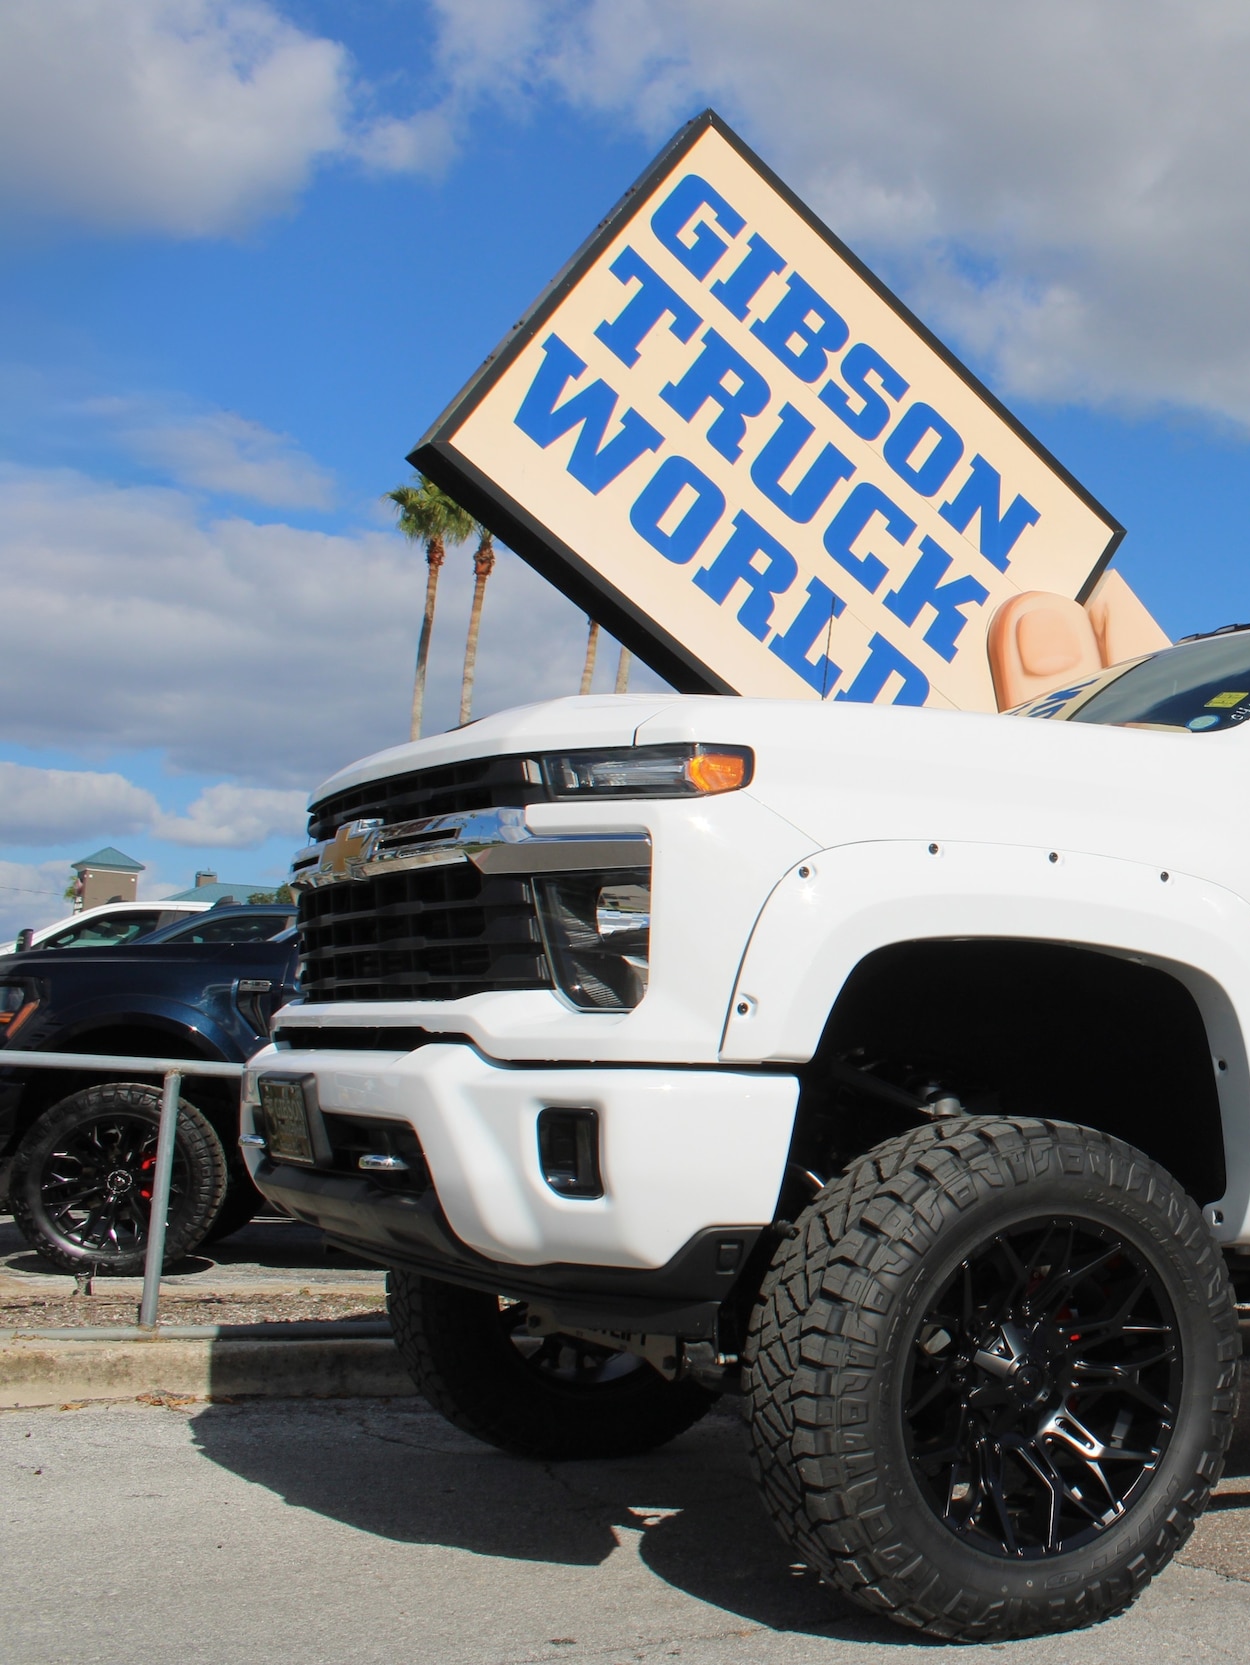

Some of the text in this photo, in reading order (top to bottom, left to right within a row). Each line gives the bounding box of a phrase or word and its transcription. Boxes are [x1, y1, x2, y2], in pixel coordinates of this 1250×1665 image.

[513, 332, 931, 708] WORLD
[593, 245, 990, 664] TRUCK
[650, 174, 1042, 573] GIBSON
